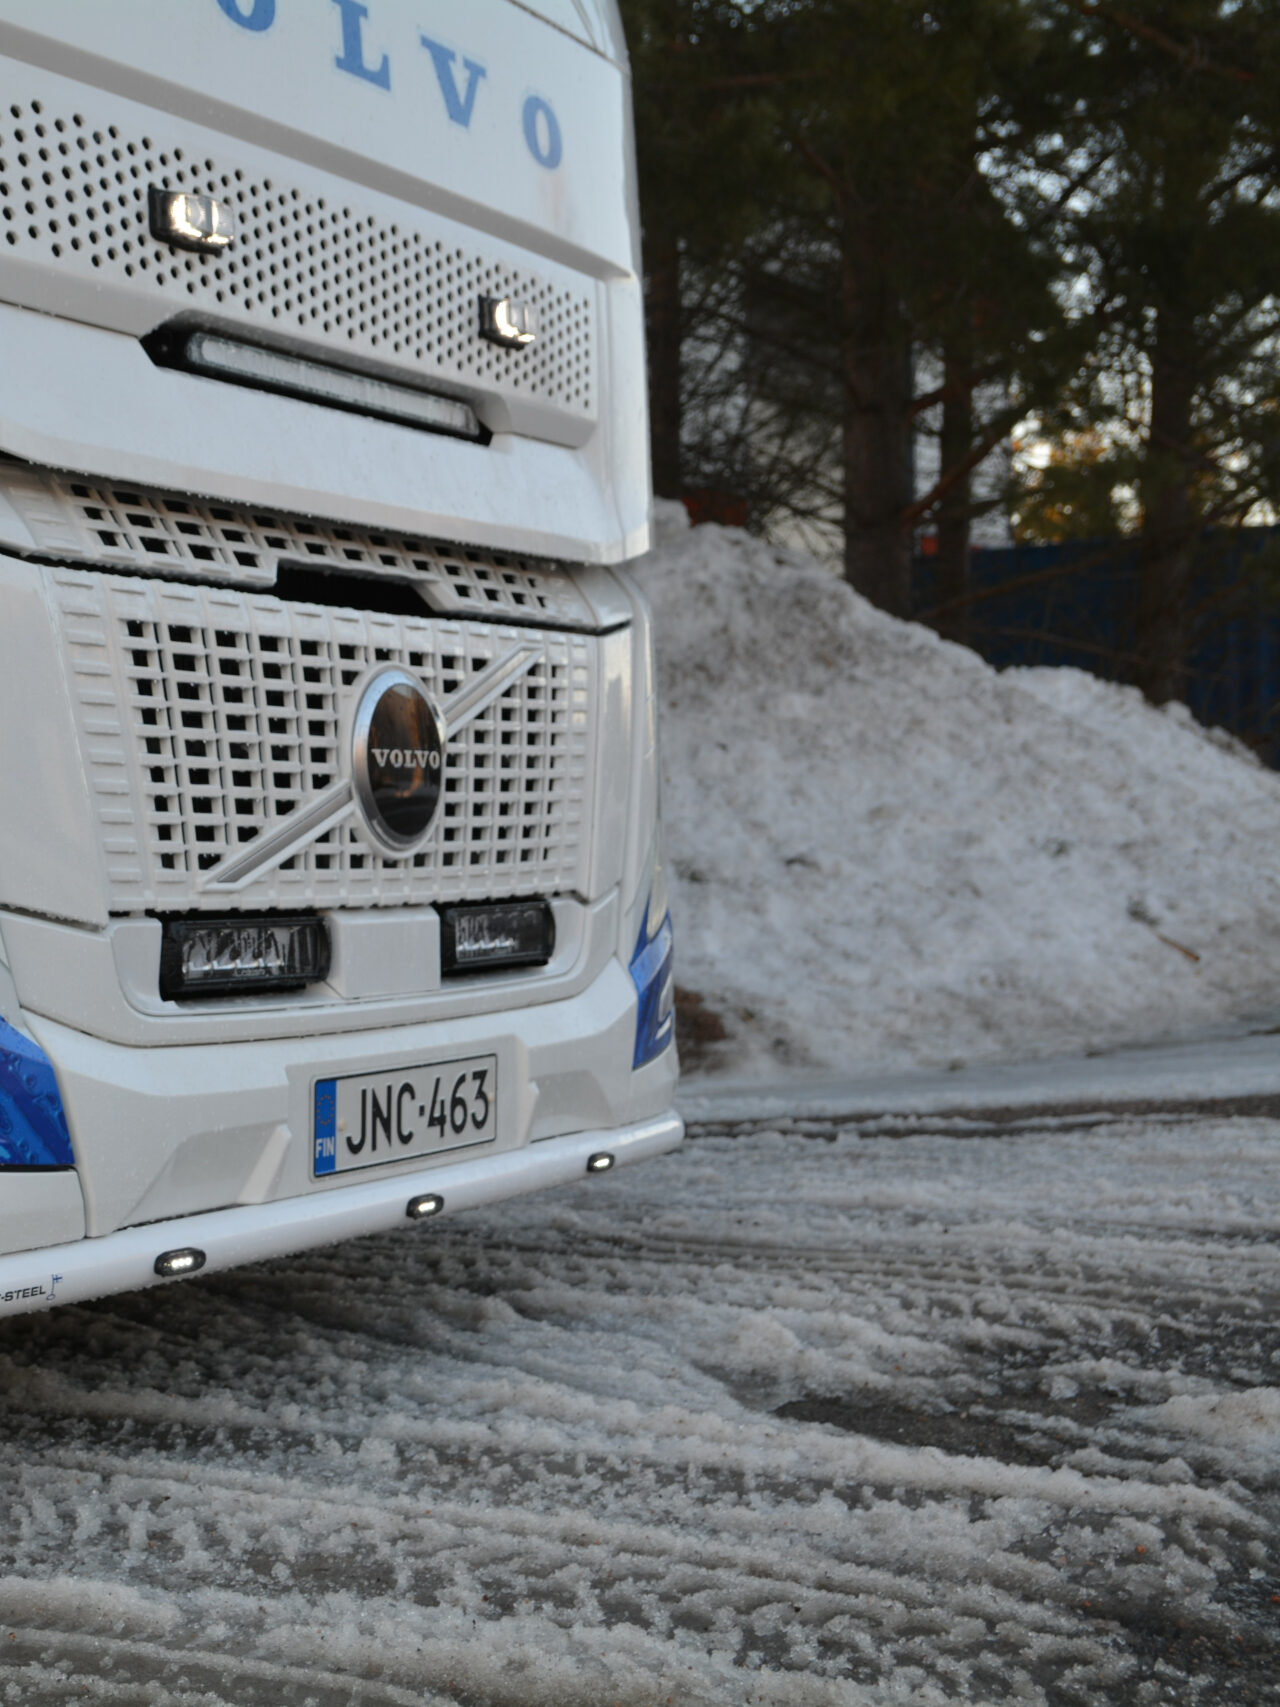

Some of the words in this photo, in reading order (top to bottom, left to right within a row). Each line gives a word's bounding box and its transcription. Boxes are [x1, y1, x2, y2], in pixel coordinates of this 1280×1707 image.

[371, 748, 441, 770] VOLVO
[346, 1069, 489, 1155] JNC-463
[315, 1136, 335, 1159] FIN
